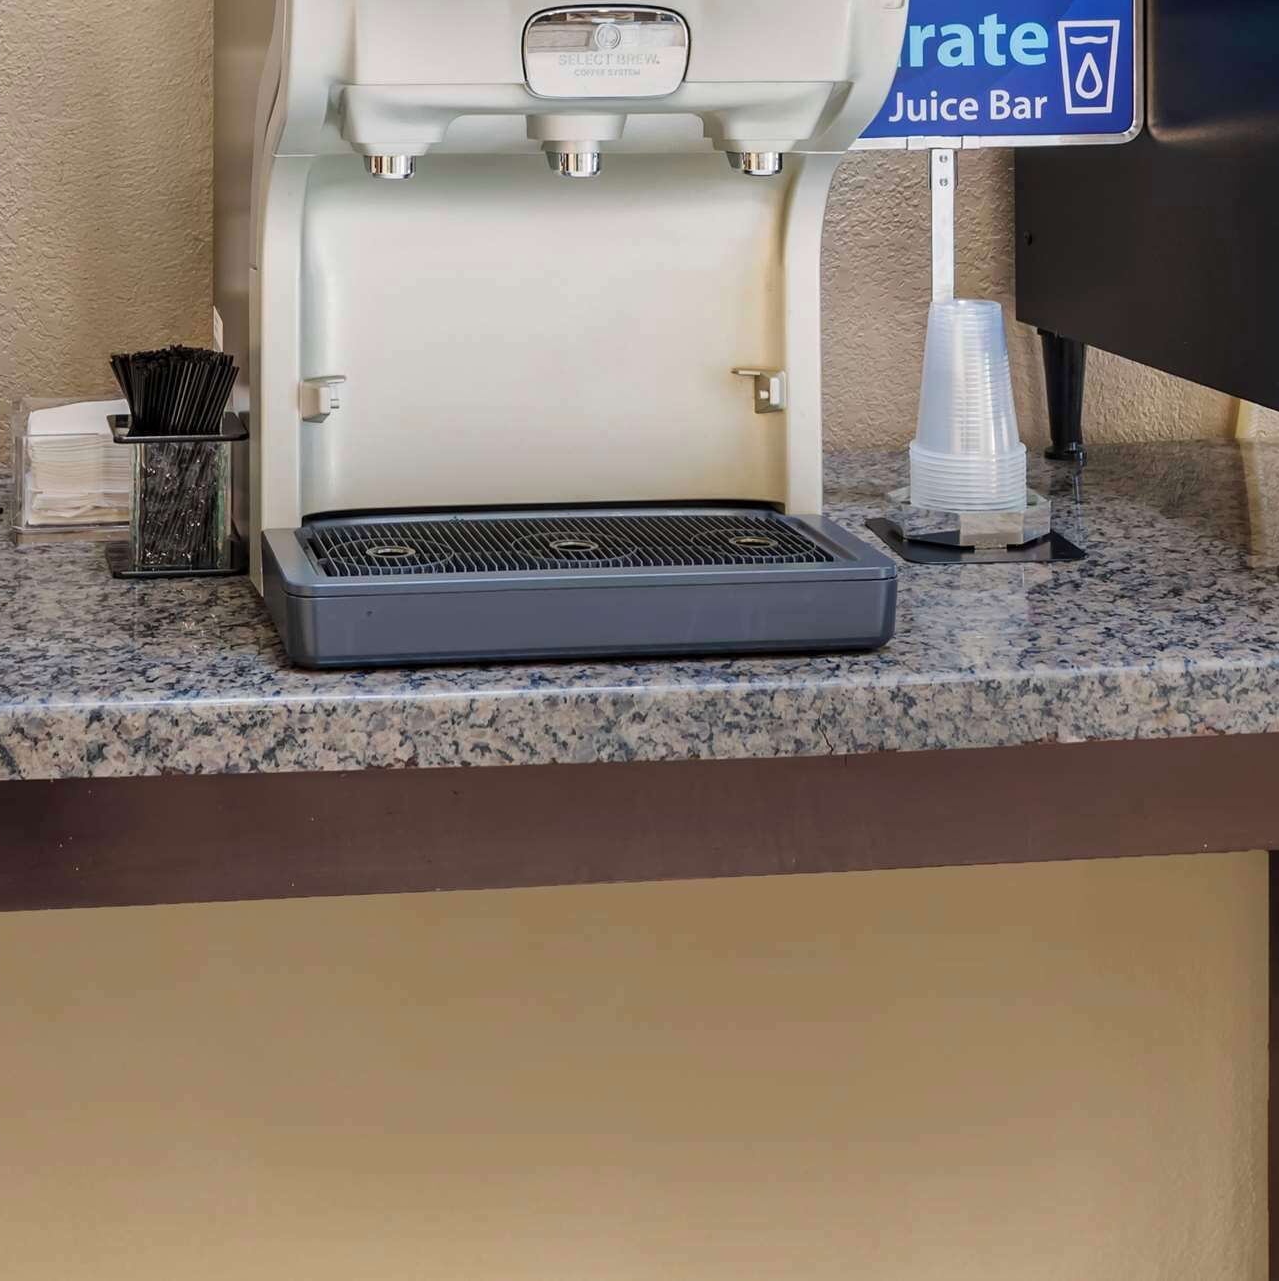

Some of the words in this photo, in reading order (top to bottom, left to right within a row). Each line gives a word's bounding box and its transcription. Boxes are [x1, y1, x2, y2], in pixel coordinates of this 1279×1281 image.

[898, 14, 1049, 68] rate
[558, 53, 611, 65] SELECT
[607, 68, 641, 76] SYSTEM
[888, 90, 979, 122] Juice
[989, 89, 1048, 120] Bar
